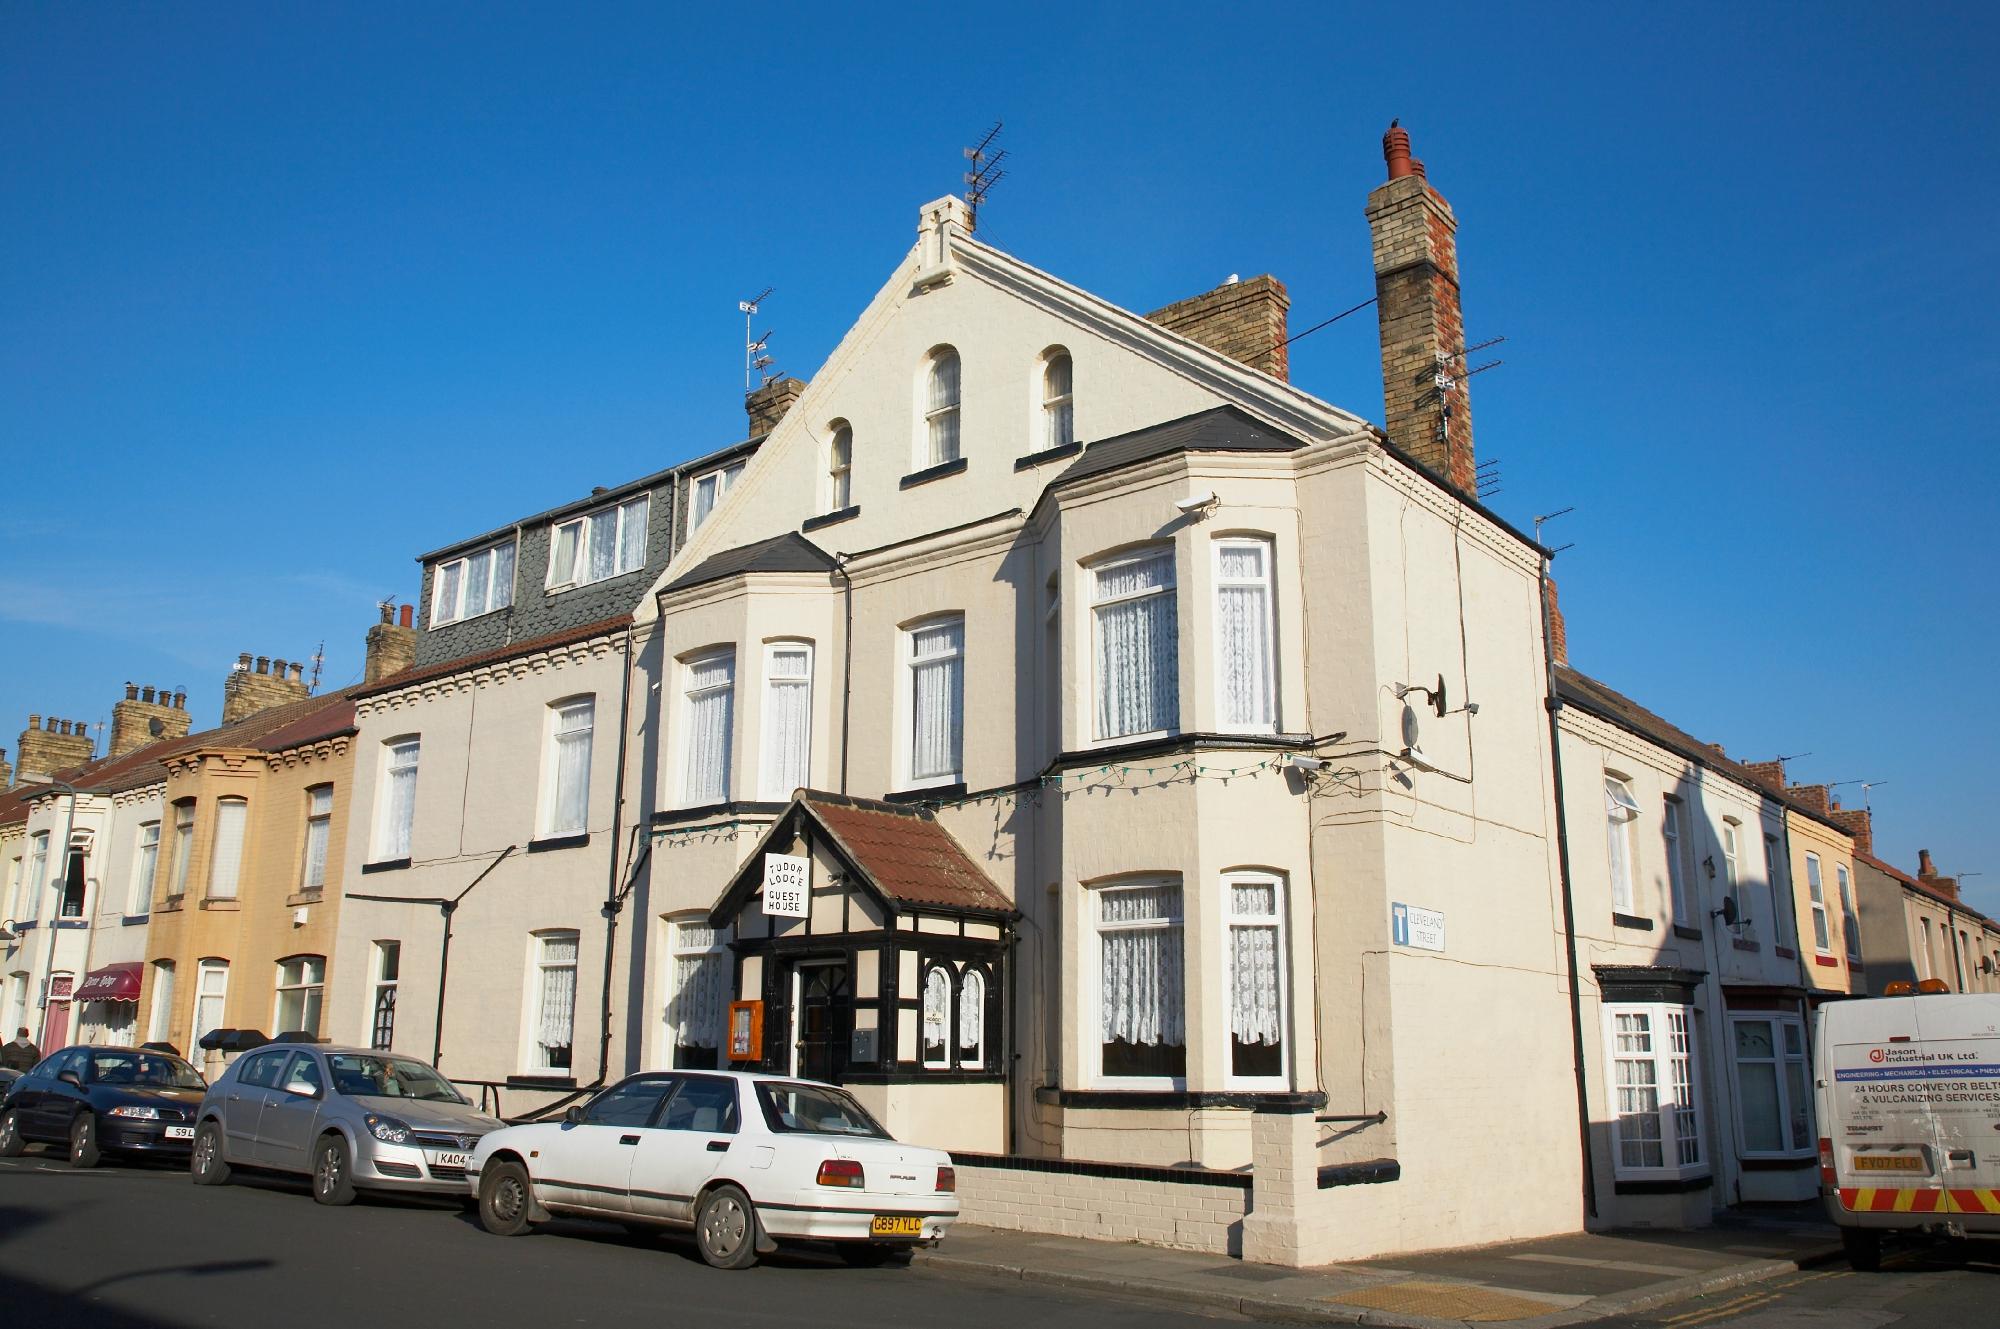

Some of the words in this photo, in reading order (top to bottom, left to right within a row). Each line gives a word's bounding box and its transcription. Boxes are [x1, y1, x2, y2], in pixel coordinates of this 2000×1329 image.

[769, 863, 803, 875] TUDOR
[769, 874, 804, 887] LODGE
[769, 891, 800, 902] GUEST
[768, 901, 800, 912] HOUSE
[1409, 912, 1443, 930] CLEVELAND
[1416, 929, 1437, 945] STREET
[1885, 1048, 1916, 1056] Jason
[1885, 1053, 1935, 1062] Industrial
[1937, 1053, 1954, 1061] UK
[1836, 1071, 1880, 1079] ENGINEERING
[1855, 1085, 1866, 1093] 24
[1868, 1084, 1905, 1092] HOURS
[1907, 1082, 1968, 1092] CONVEYOR
[1970, 1081, 2000, 1090] BELT
[1862, 1095, 1870, 1103] &
[1871, 1093, 1943, 1103] VULCANIZING
[1945, 1092, 2000, 1102] SERVICES
[175, 1128, 187, 1137] S9
[440, 1153, 465, 1165] KA04
[874, 1217, 900, 1231] G897
[902, 1218, 921, 1231] YLC
